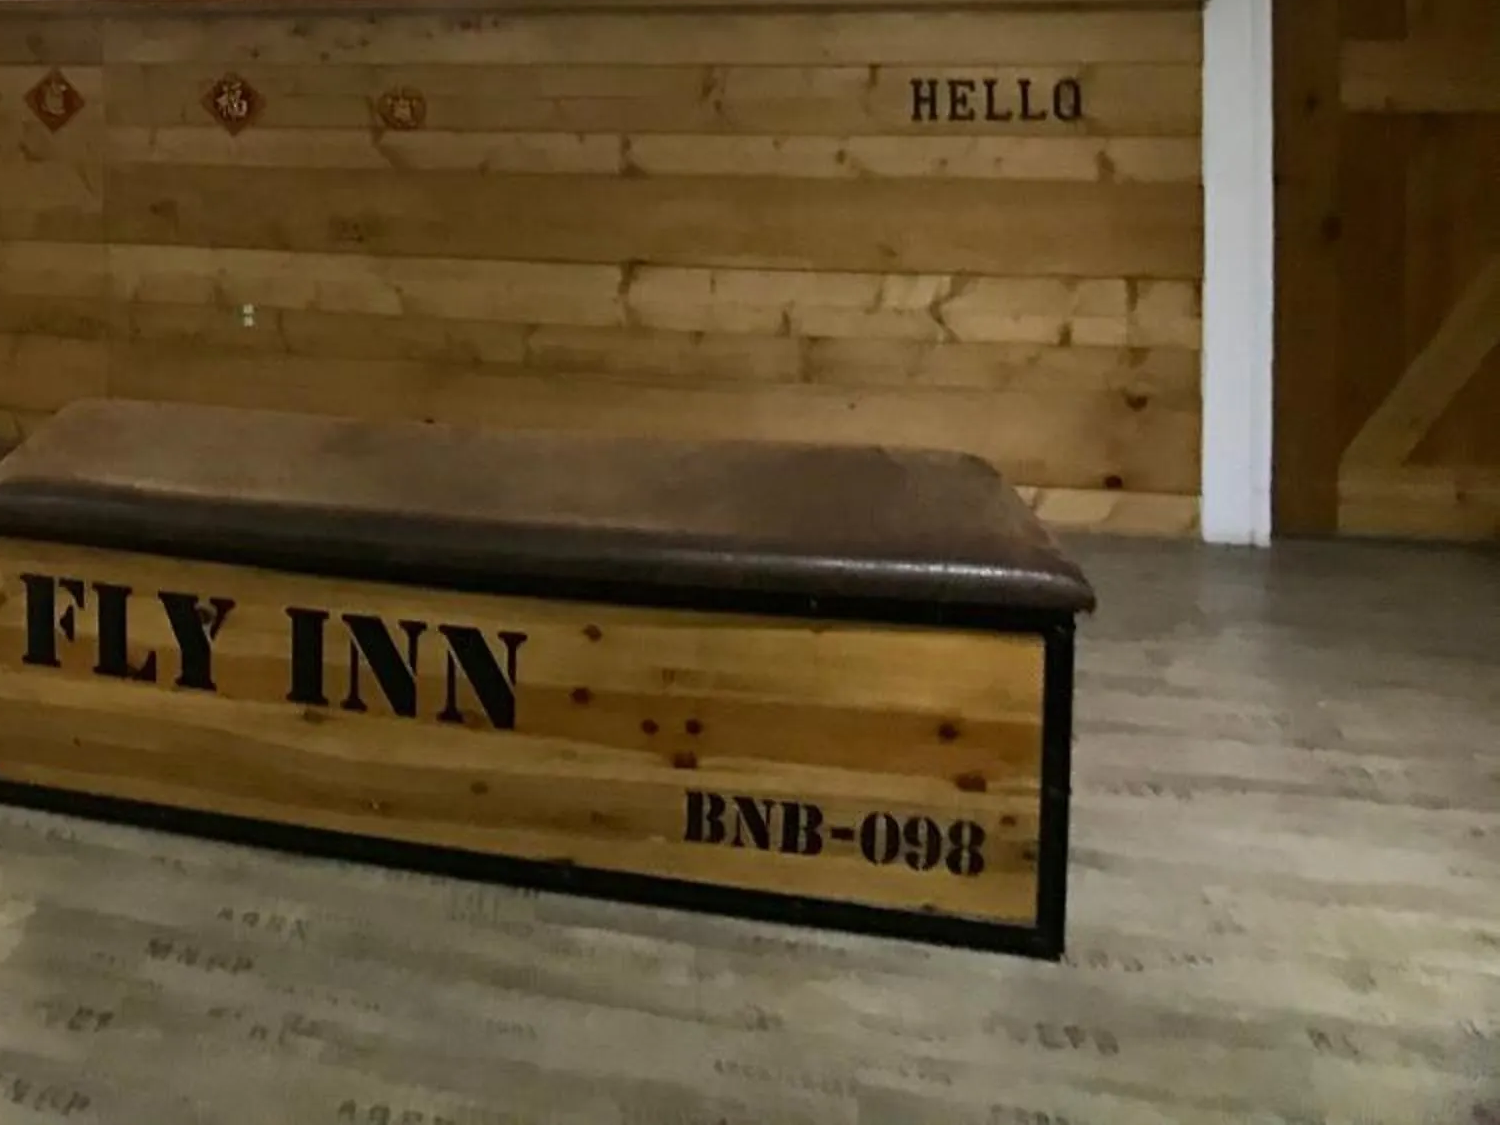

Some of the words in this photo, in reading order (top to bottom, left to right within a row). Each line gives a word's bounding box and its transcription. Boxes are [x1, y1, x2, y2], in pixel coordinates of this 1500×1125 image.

[910, 78, 1083, 121] HELLO
[20, 573, 236, 692] FLY
[286, 607, 528, 730] INN
[683, 788, 987, 876] BNB-098
